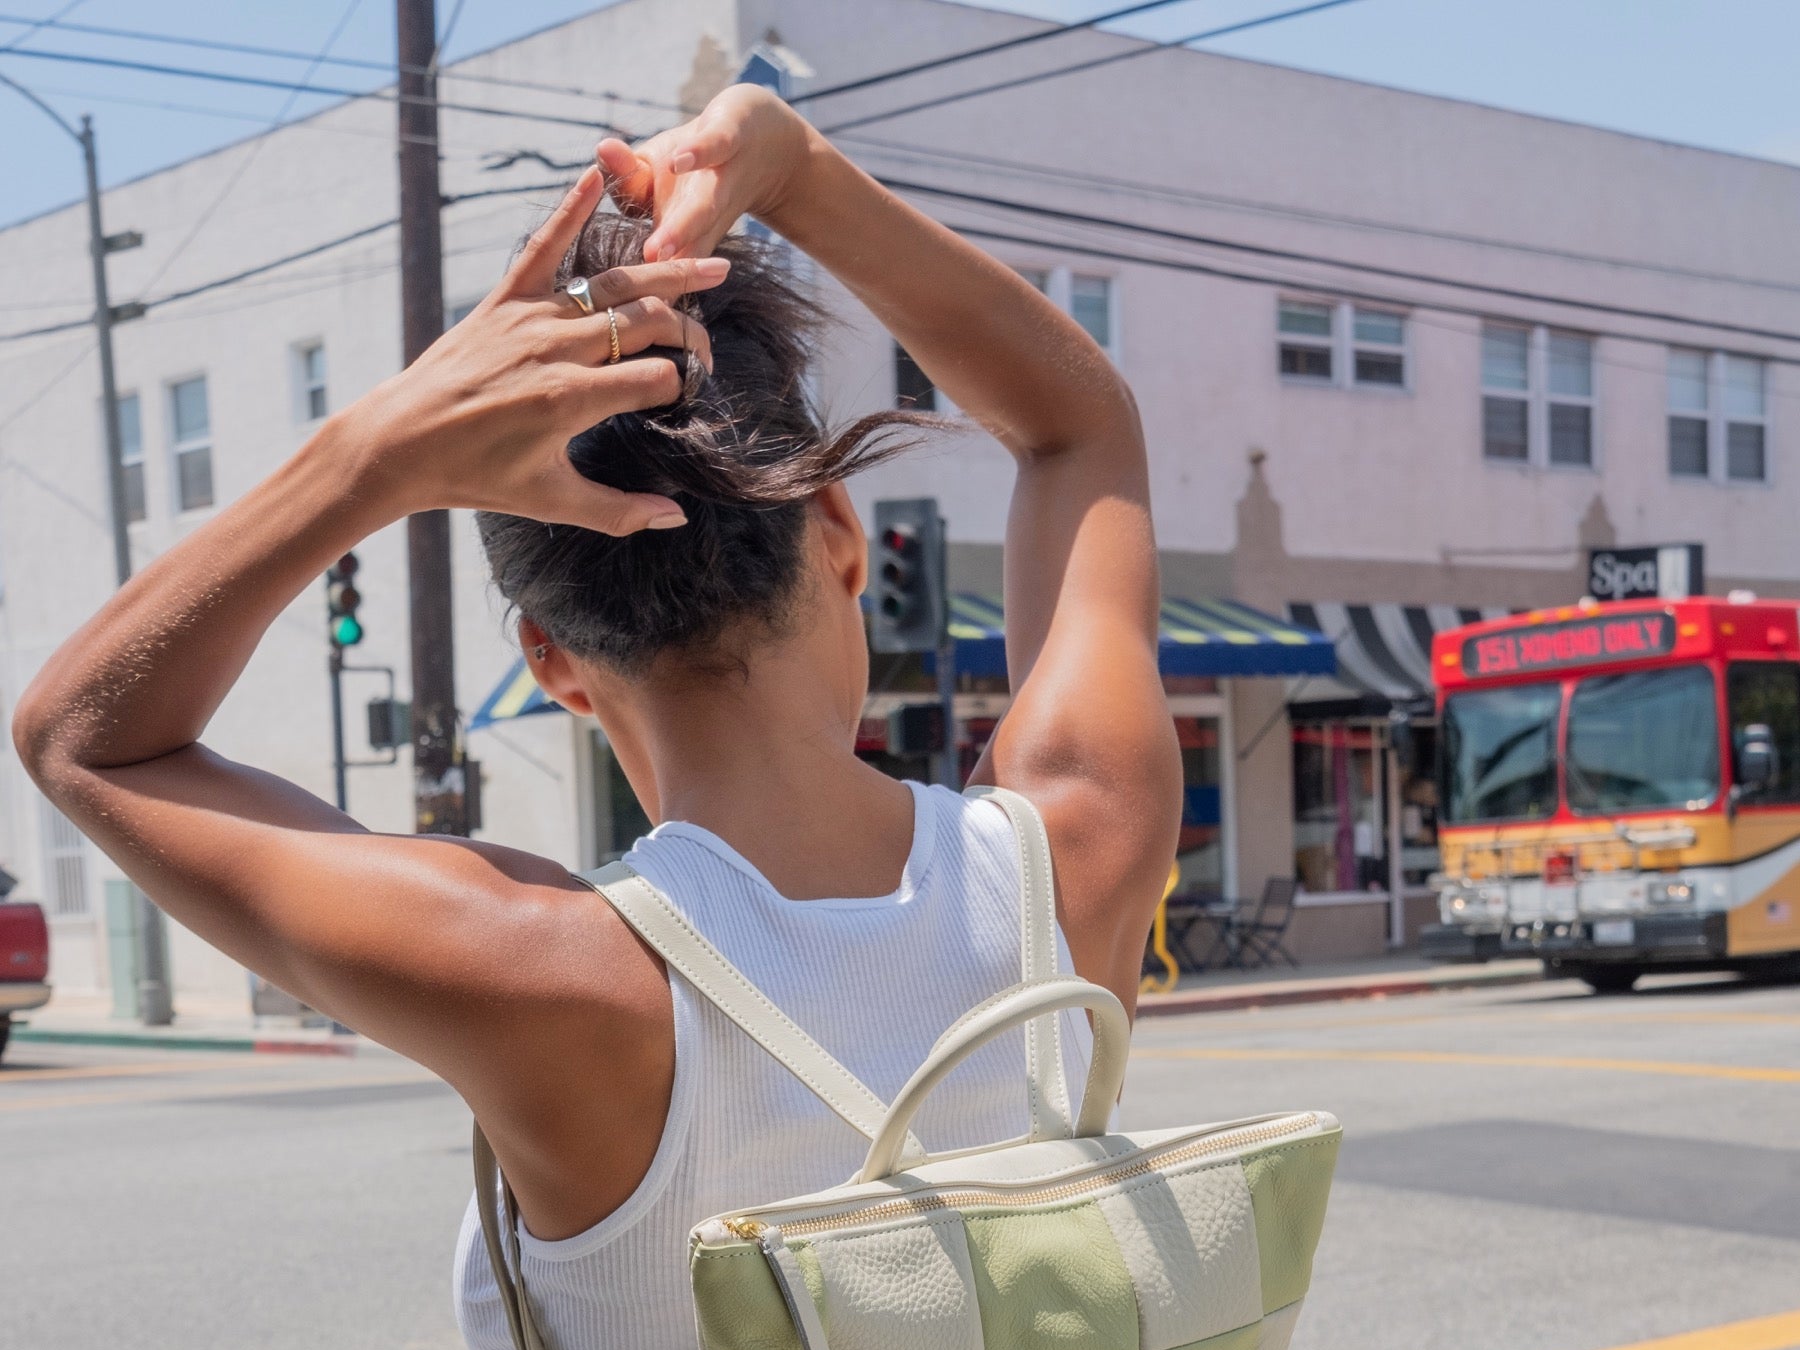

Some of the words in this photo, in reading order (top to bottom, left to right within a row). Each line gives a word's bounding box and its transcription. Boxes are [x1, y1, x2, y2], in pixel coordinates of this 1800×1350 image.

[1591, 553, 1656, 599] Spa
[1476, 636, 1518, 673] 151
[1603, 617, 1663, 653] ONLY
